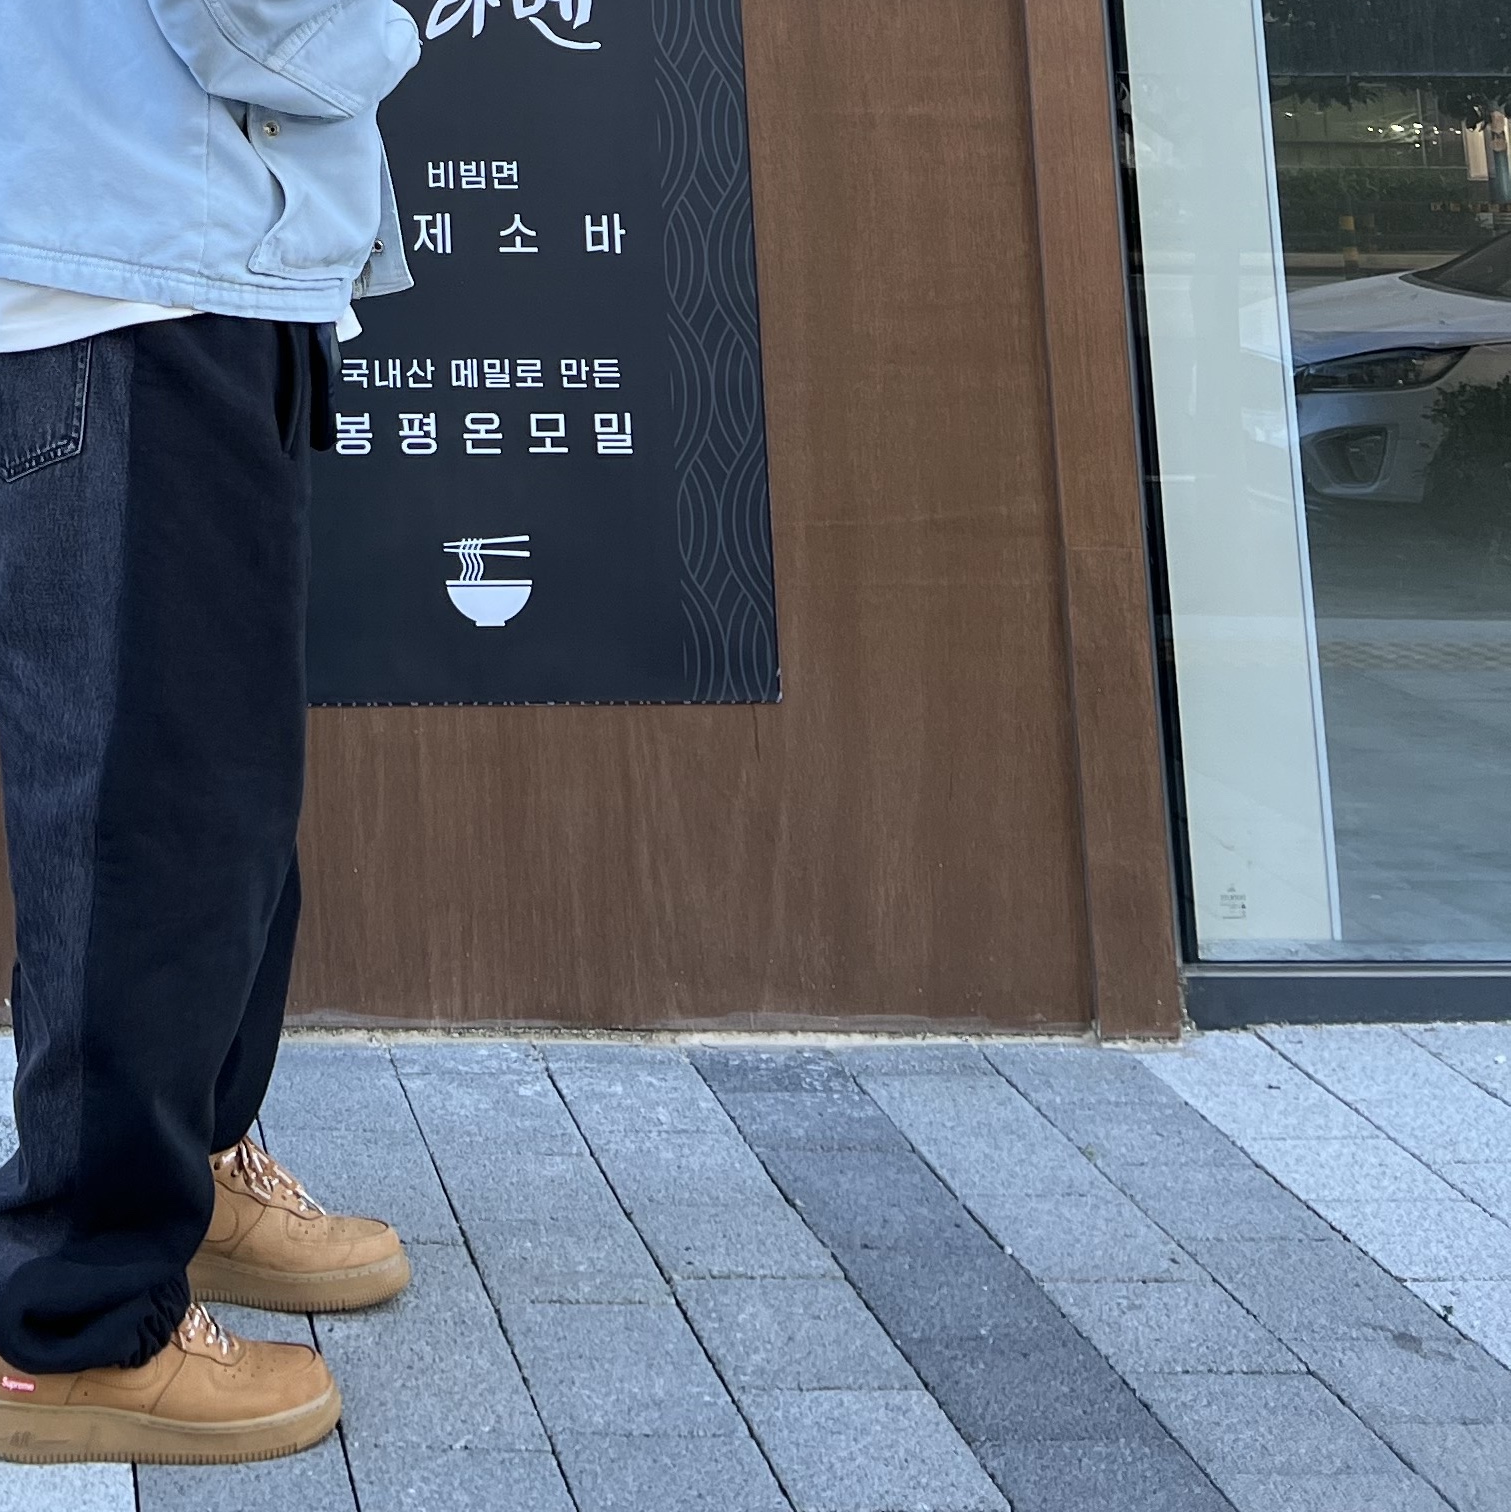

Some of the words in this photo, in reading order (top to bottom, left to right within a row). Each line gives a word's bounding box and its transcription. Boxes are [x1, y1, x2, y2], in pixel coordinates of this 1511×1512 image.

[427, 160, 519, 190] 비빔면
[341, 358, 435, 389] 국내산
[450, 358, 544, 388] 메밀로
[560, 358, 621, 388] 만든
[335, 412, 634, 456] 봉평온모밀
